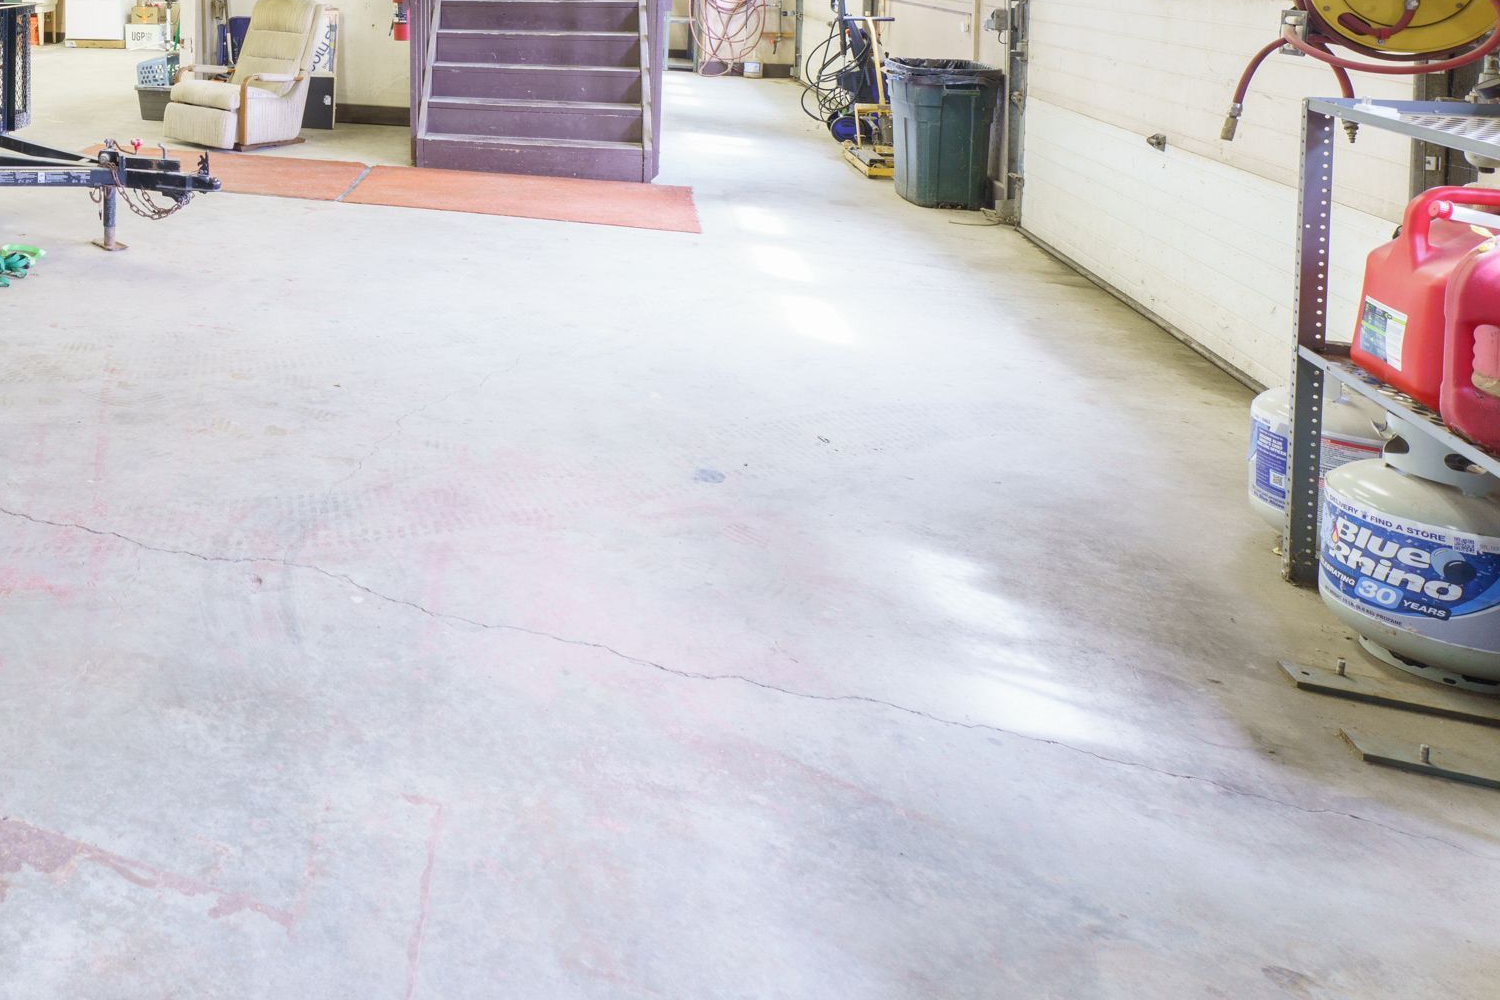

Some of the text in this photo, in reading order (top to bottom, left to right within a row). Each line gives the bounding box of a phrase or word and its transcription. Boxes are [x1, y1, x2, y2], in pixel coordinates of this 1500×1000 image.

[1329, 494, 1359, 515] DELIVERY
[1370, 515, 1393, 529] FIND
[1406, 527, 1447, 543] STORE
[1336, 516, 1432, 570] Blue
[1328, 541, 1464, 602] Rhino
[1358, 580, 1397, 605] 30
[1403, 599, 1447, 618] YEARS
